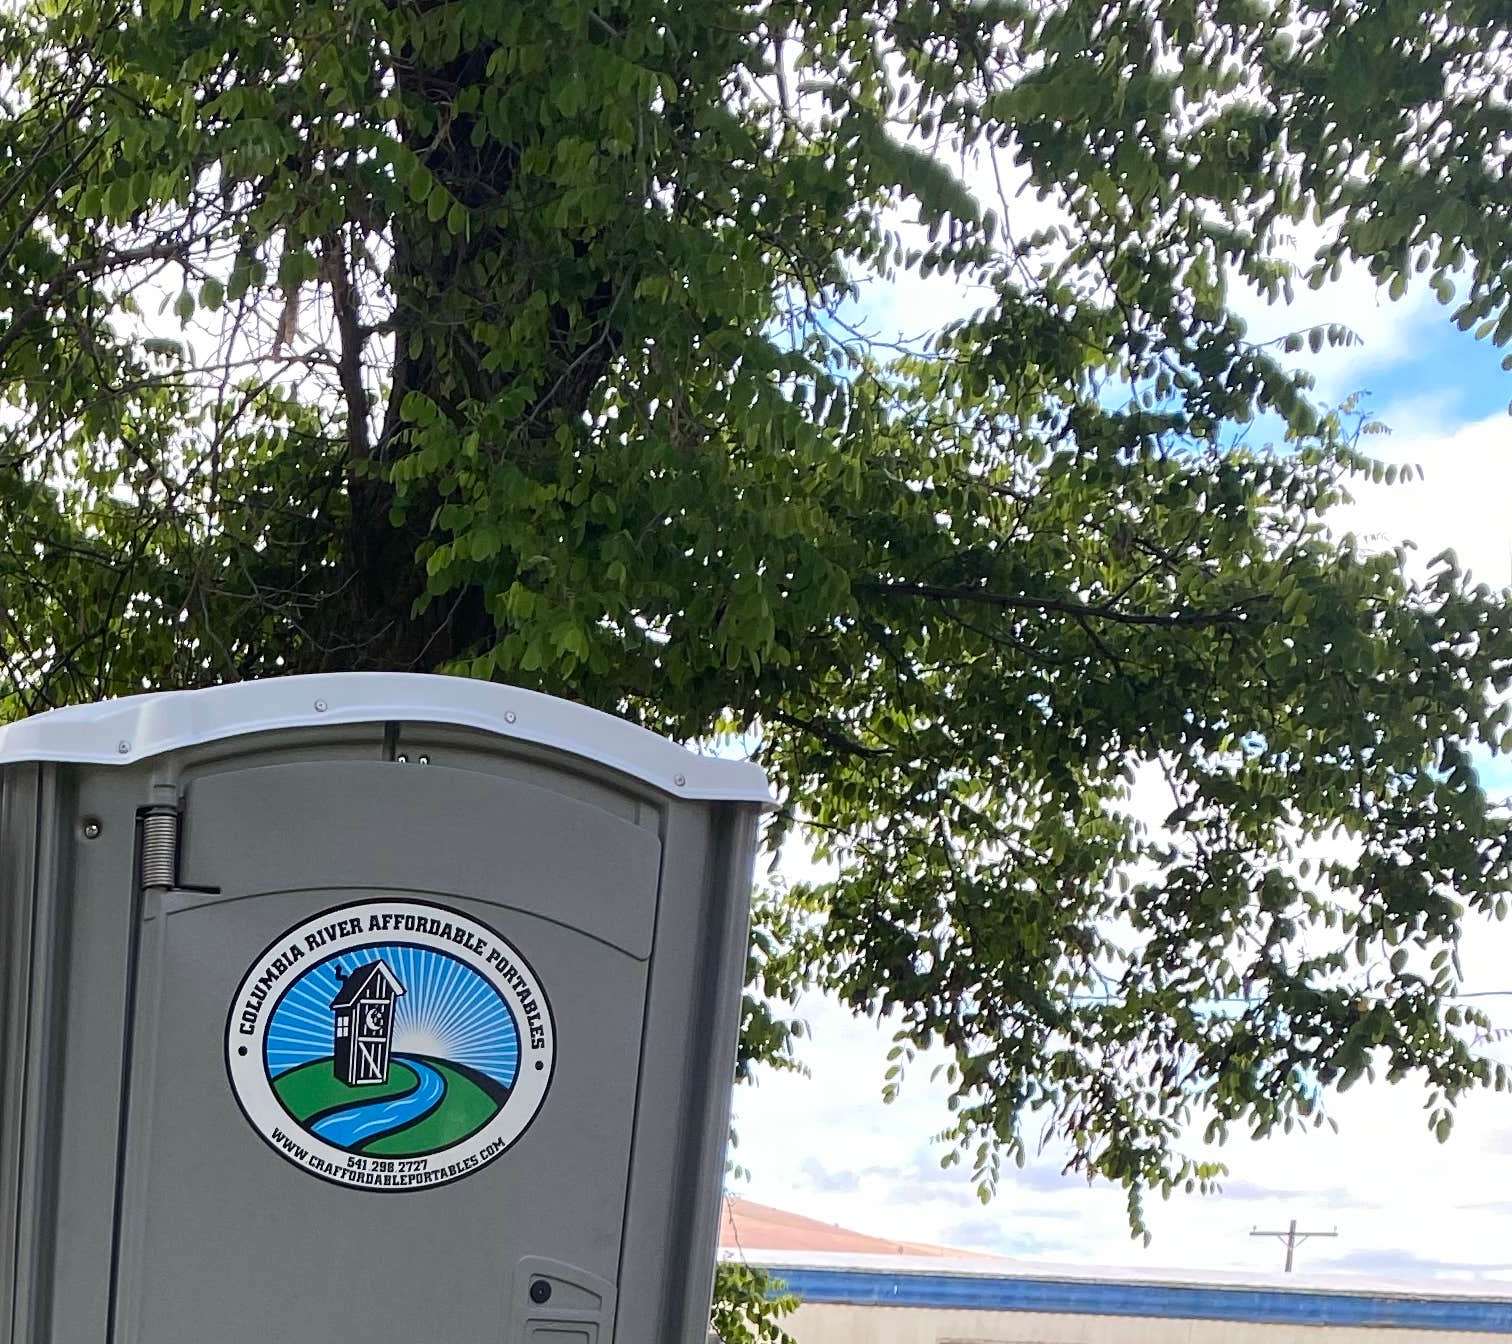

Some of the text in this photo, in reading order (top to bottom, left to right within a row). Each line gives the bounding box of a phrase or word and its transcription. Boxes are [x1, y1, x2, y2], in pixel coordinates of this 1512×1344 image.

[239, 914, 545, 1050] COLUMBIA RIVER AFFORDABLE PORTABLES
